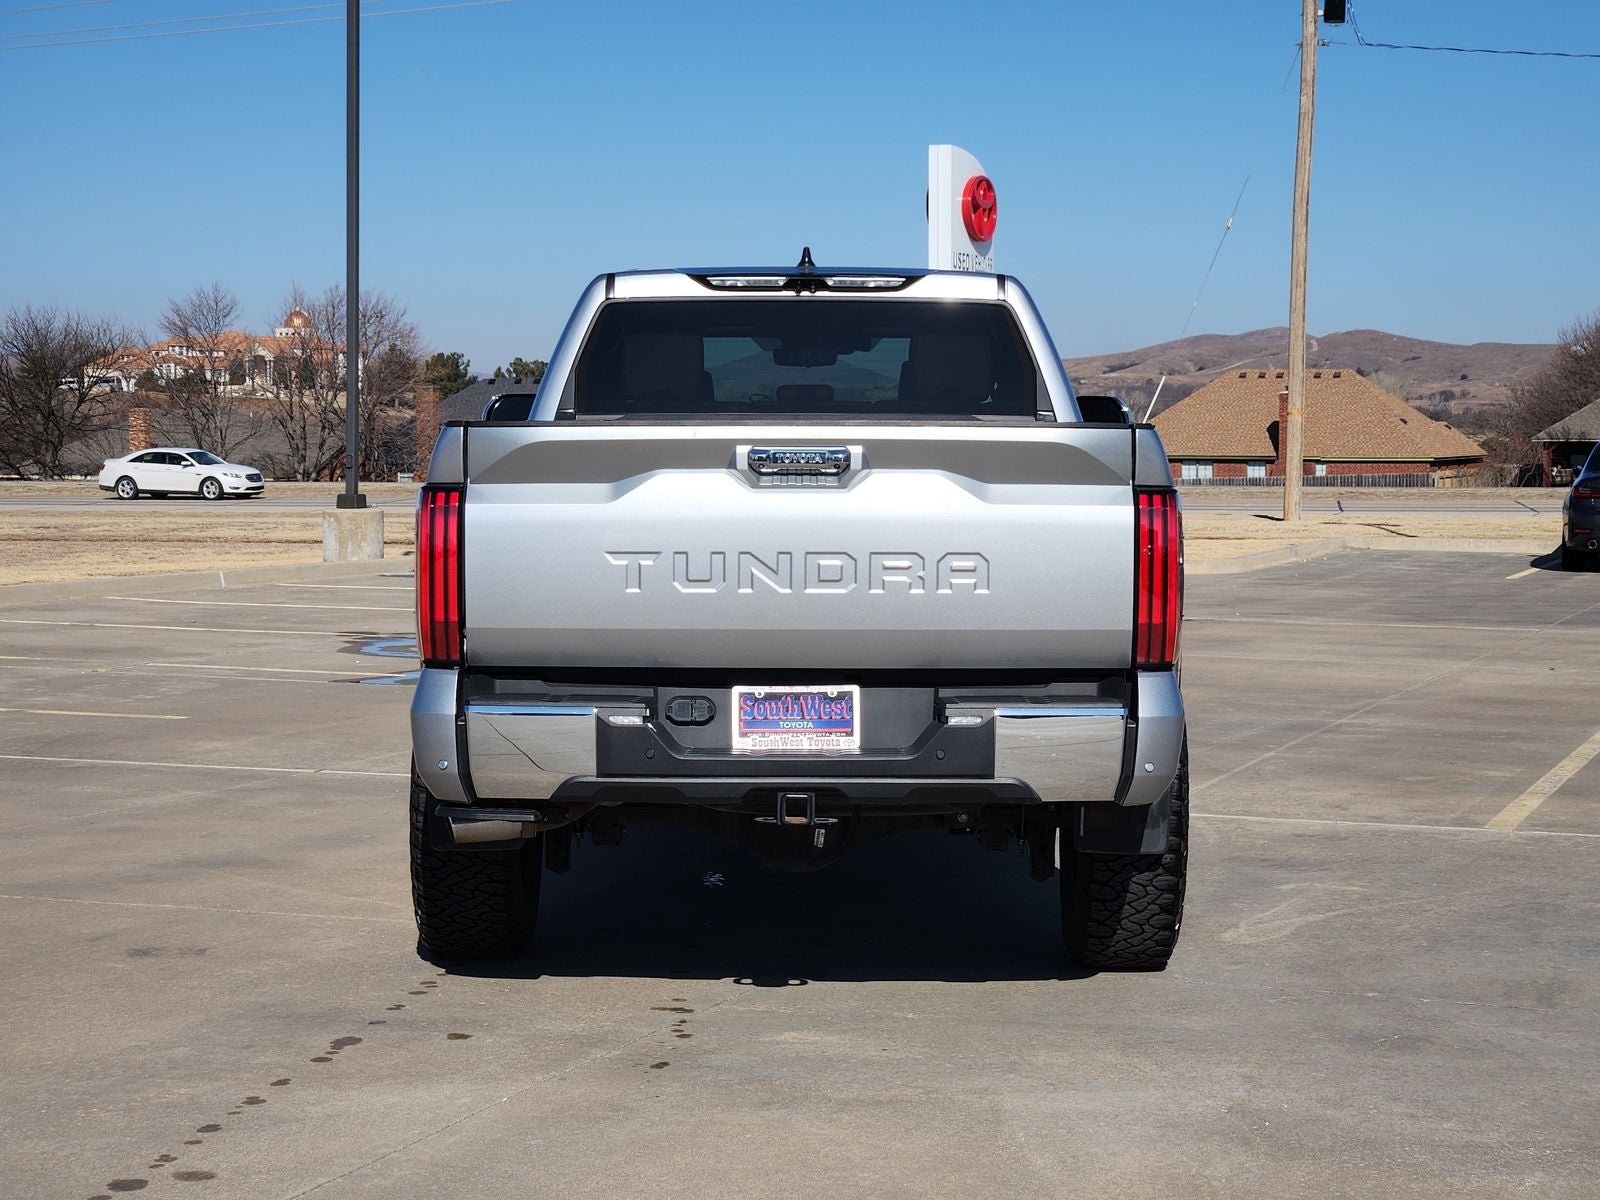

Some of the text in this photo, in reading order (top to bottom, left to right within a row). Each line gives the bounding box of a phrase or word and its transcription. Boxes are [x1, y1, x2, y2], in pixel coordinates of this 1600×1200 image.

[952, 252, 969, 271] USED
[775, 453, 823, 463] TOYOTA
[603, 551, 990, 594] TUNDRA
[740, 694, 853, 720] SouthWest
[751, 738, 841, 749] SouthWest Toyota
